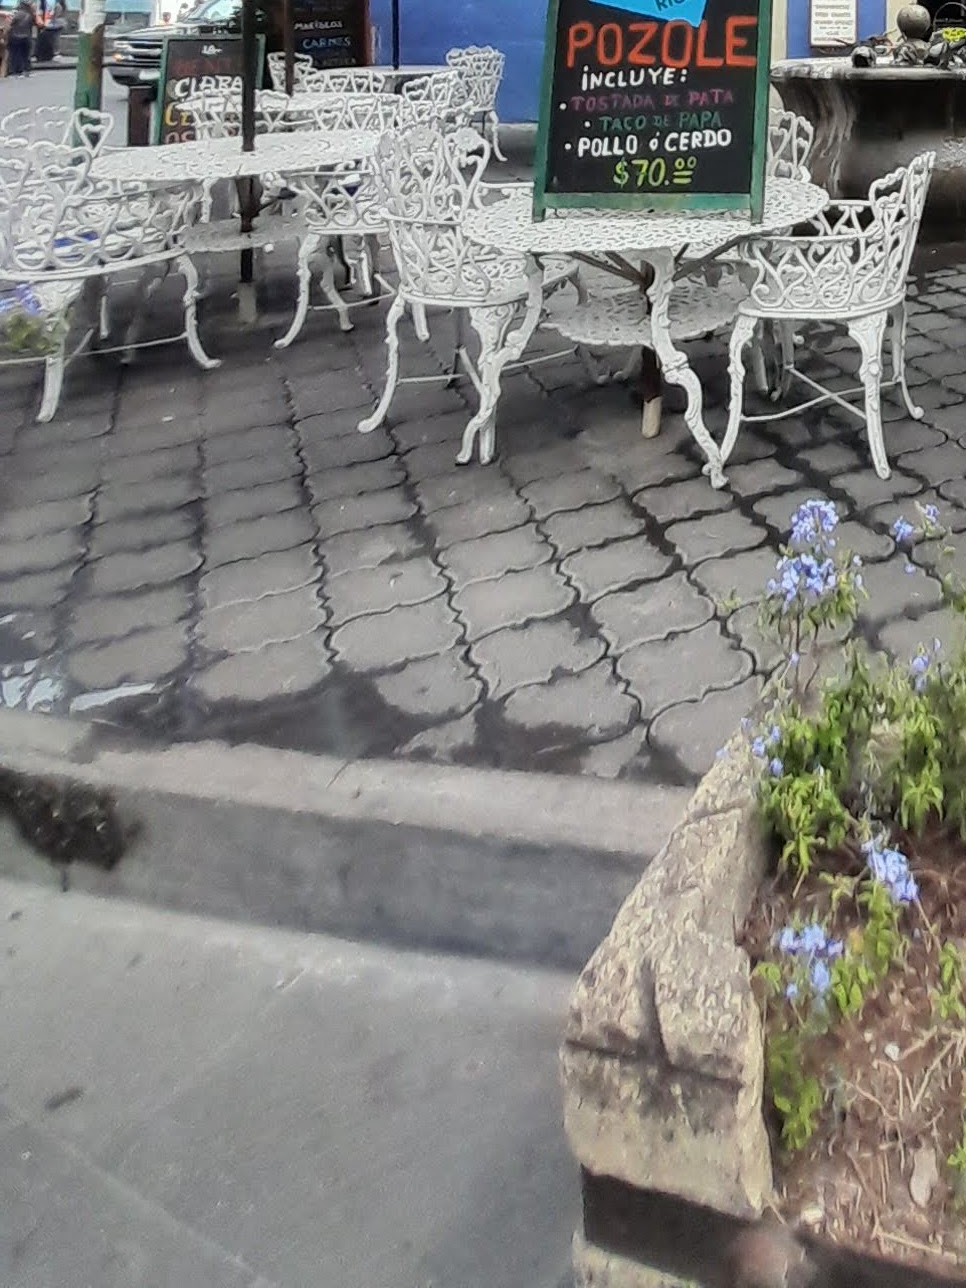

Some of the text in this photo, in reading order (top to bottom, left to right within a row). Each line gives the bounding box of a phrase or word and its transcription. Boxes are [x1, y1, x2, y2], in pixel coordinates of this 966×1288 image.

[566, 15, 759, 68] POZOLE
[569, 92, 655, 112] TOSTADA
[688, 88, 734, 105] PATA
[599, 115, 648, 132] TACO
[679, 111, 723, 130] PAPA
[577, 134, 638, 158] POLLO
[664, 128, 732, 152] CERDO
